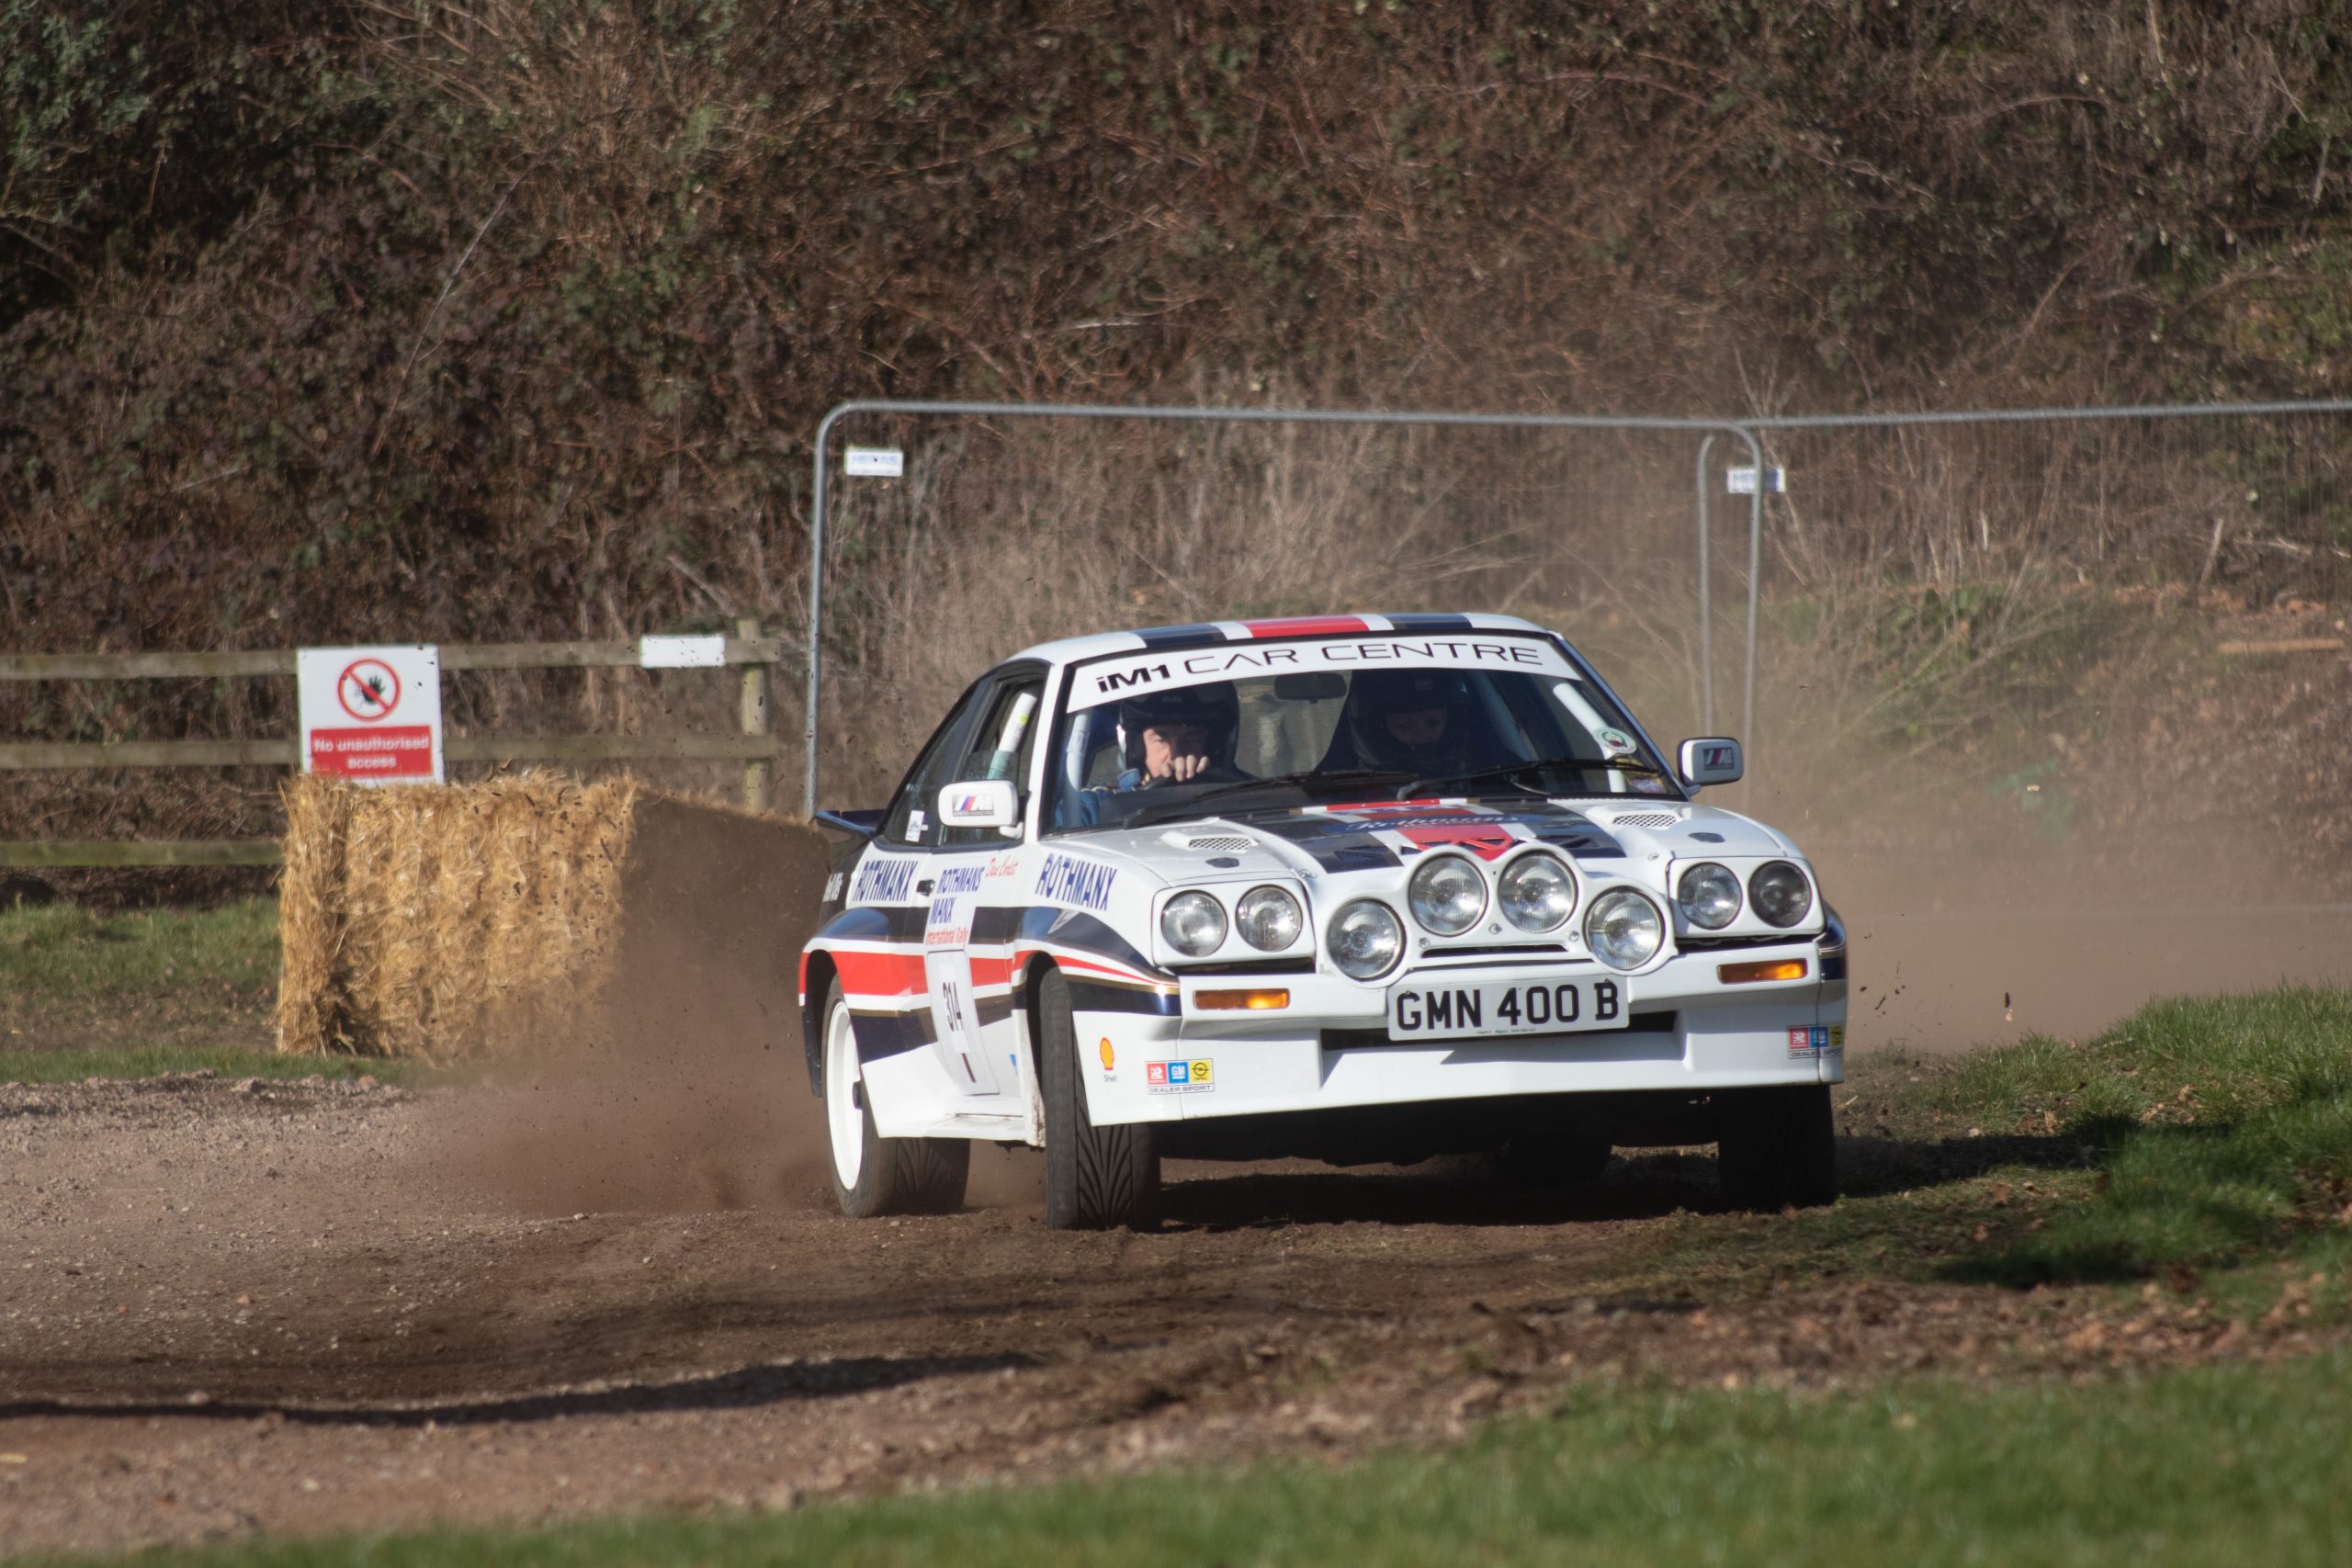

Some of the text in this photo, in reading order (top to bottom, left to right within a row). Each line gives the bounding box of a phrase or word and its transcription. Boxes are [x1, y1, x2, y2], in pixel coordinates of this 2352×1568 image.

[1183, 649, 1299, 674] CAR
[1321, 642, 1544, 666] CENTRE
[313, 736, 429, 752] No unauthorised
[346, 756, 397, 770] access
[853, 860, 919, 901] ROTHMANX
[936, 866, 986, 895] ROTHMANS
[1035, 852, 1118, 911] ROTHMANX
[930, 897, 956, 924] MANX
[943, 981, 964, 1032] 314
[1396, 981, 1619, 1032] GMN 400 B
[1103, 1074, 1118, 1083] Shell
[1170, 1065, 1186, 1077] GM
[1182, 1084, 1212, 1092] SPORT
